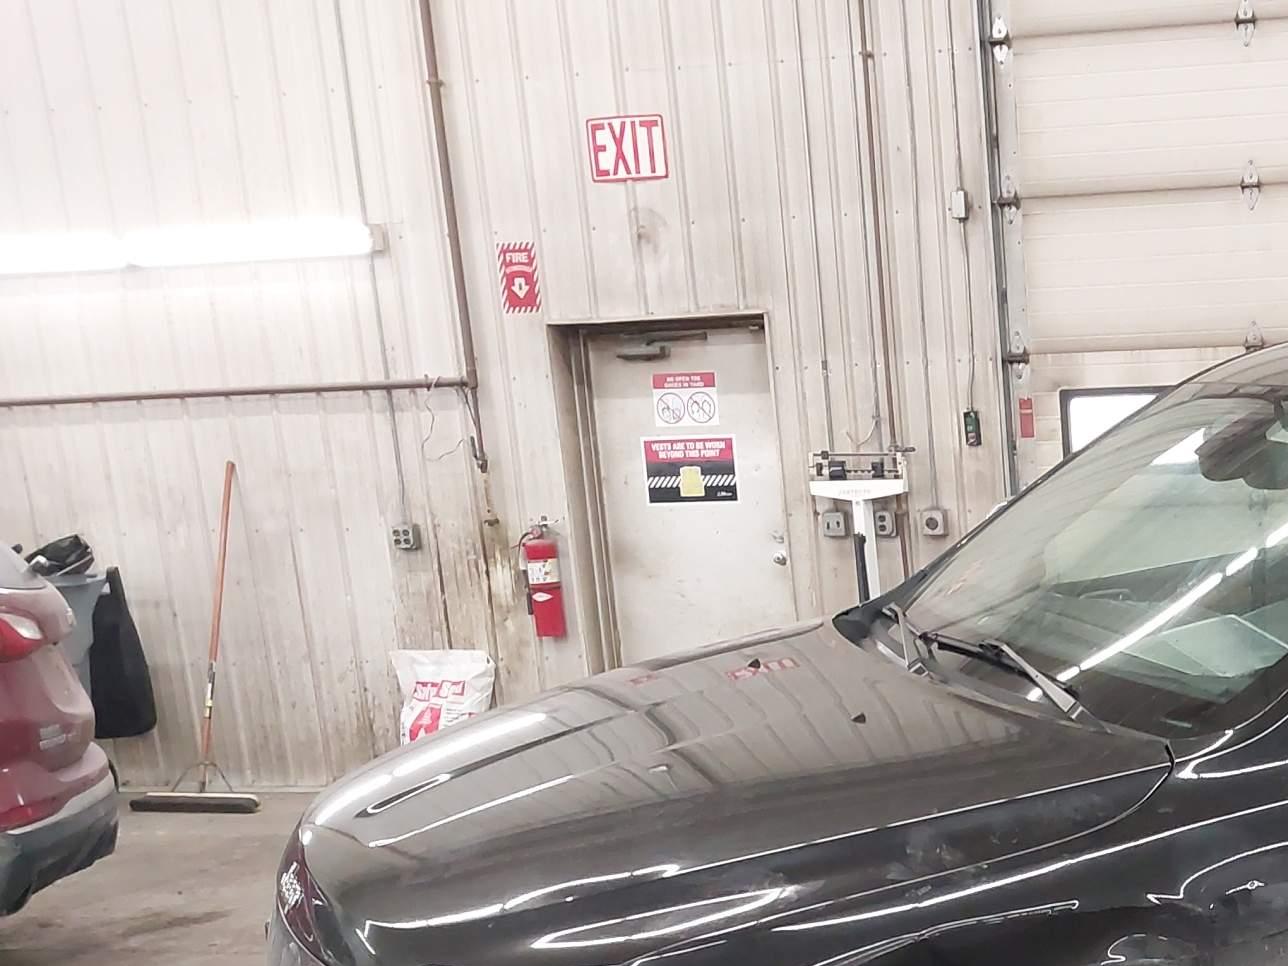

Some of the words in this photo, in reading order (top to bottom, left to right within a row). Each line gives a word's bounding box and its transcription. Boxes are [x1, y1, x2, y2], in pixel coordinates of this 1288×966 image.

[590, 120, 659, 177] EXIT
[505, 252, 529, 264] FIRE
[672, 442, 685, 450] ARE
[658, 450, 684, 459] BEYOND
[685, 450, 700, 458] THIS
[700, 449, 720, 457] POINT
